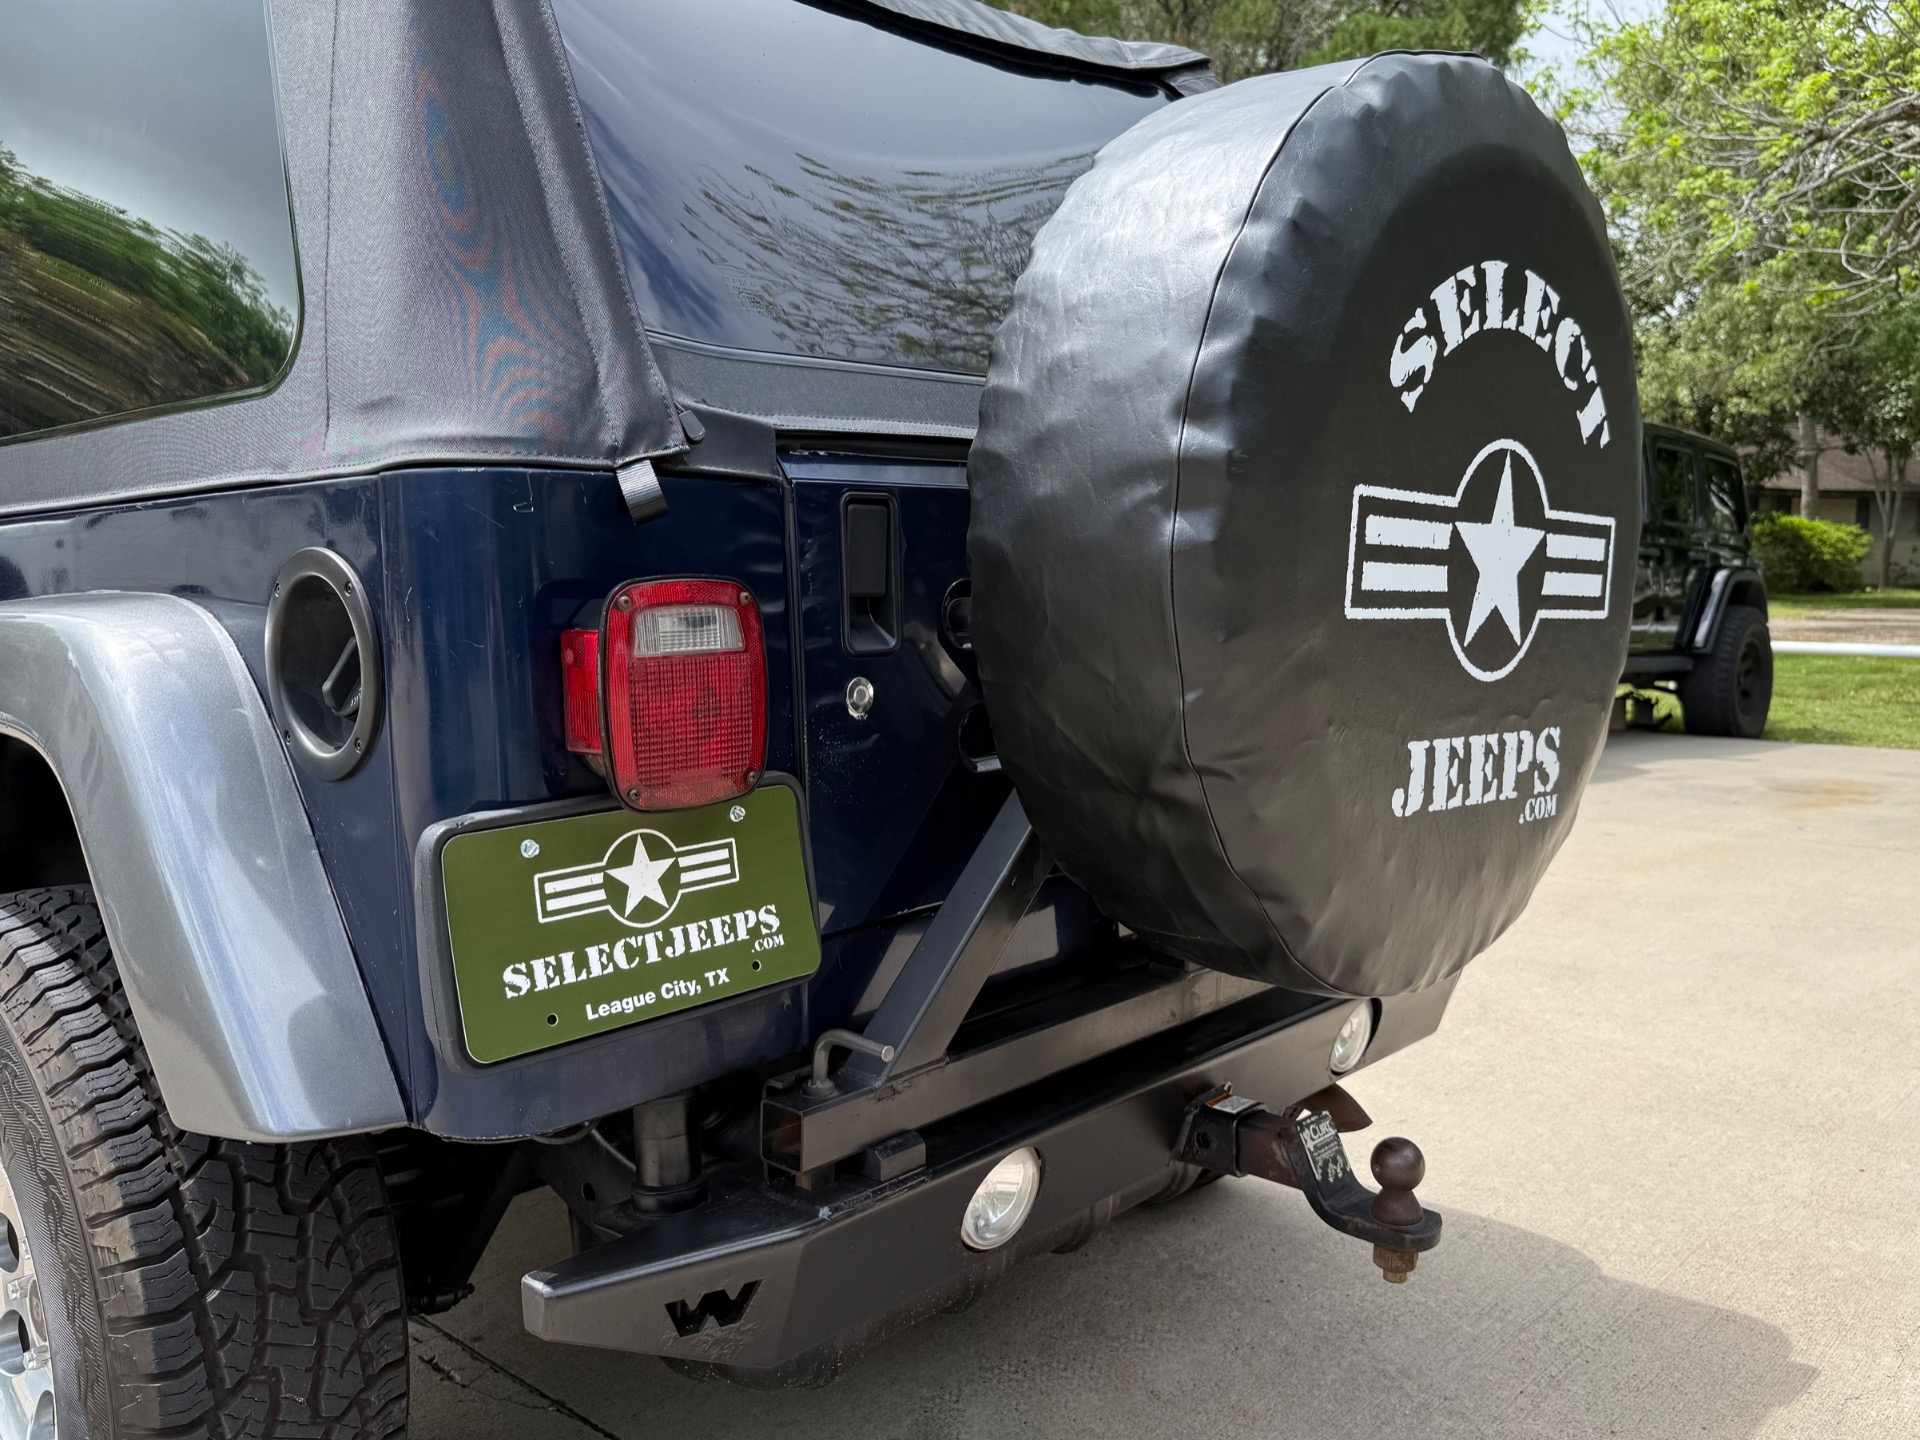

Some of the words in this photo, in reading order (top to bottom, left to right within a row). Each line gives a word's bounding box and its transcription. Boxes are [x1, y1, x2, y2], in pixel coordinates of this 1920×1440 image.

[1389, 260, 1610, 449] SELECT
[1391, 726, 1561, 818] JEEPS
[1518, 793, 1558, 825] .COM
[502, 904, 781, 999] SELECTJEEPS
[751, 933, 785, 954] .COM
[585, 990, 657, 1021] League
[660, 977, 702, 1000] City,
[703, 967, 731, 988] TX
